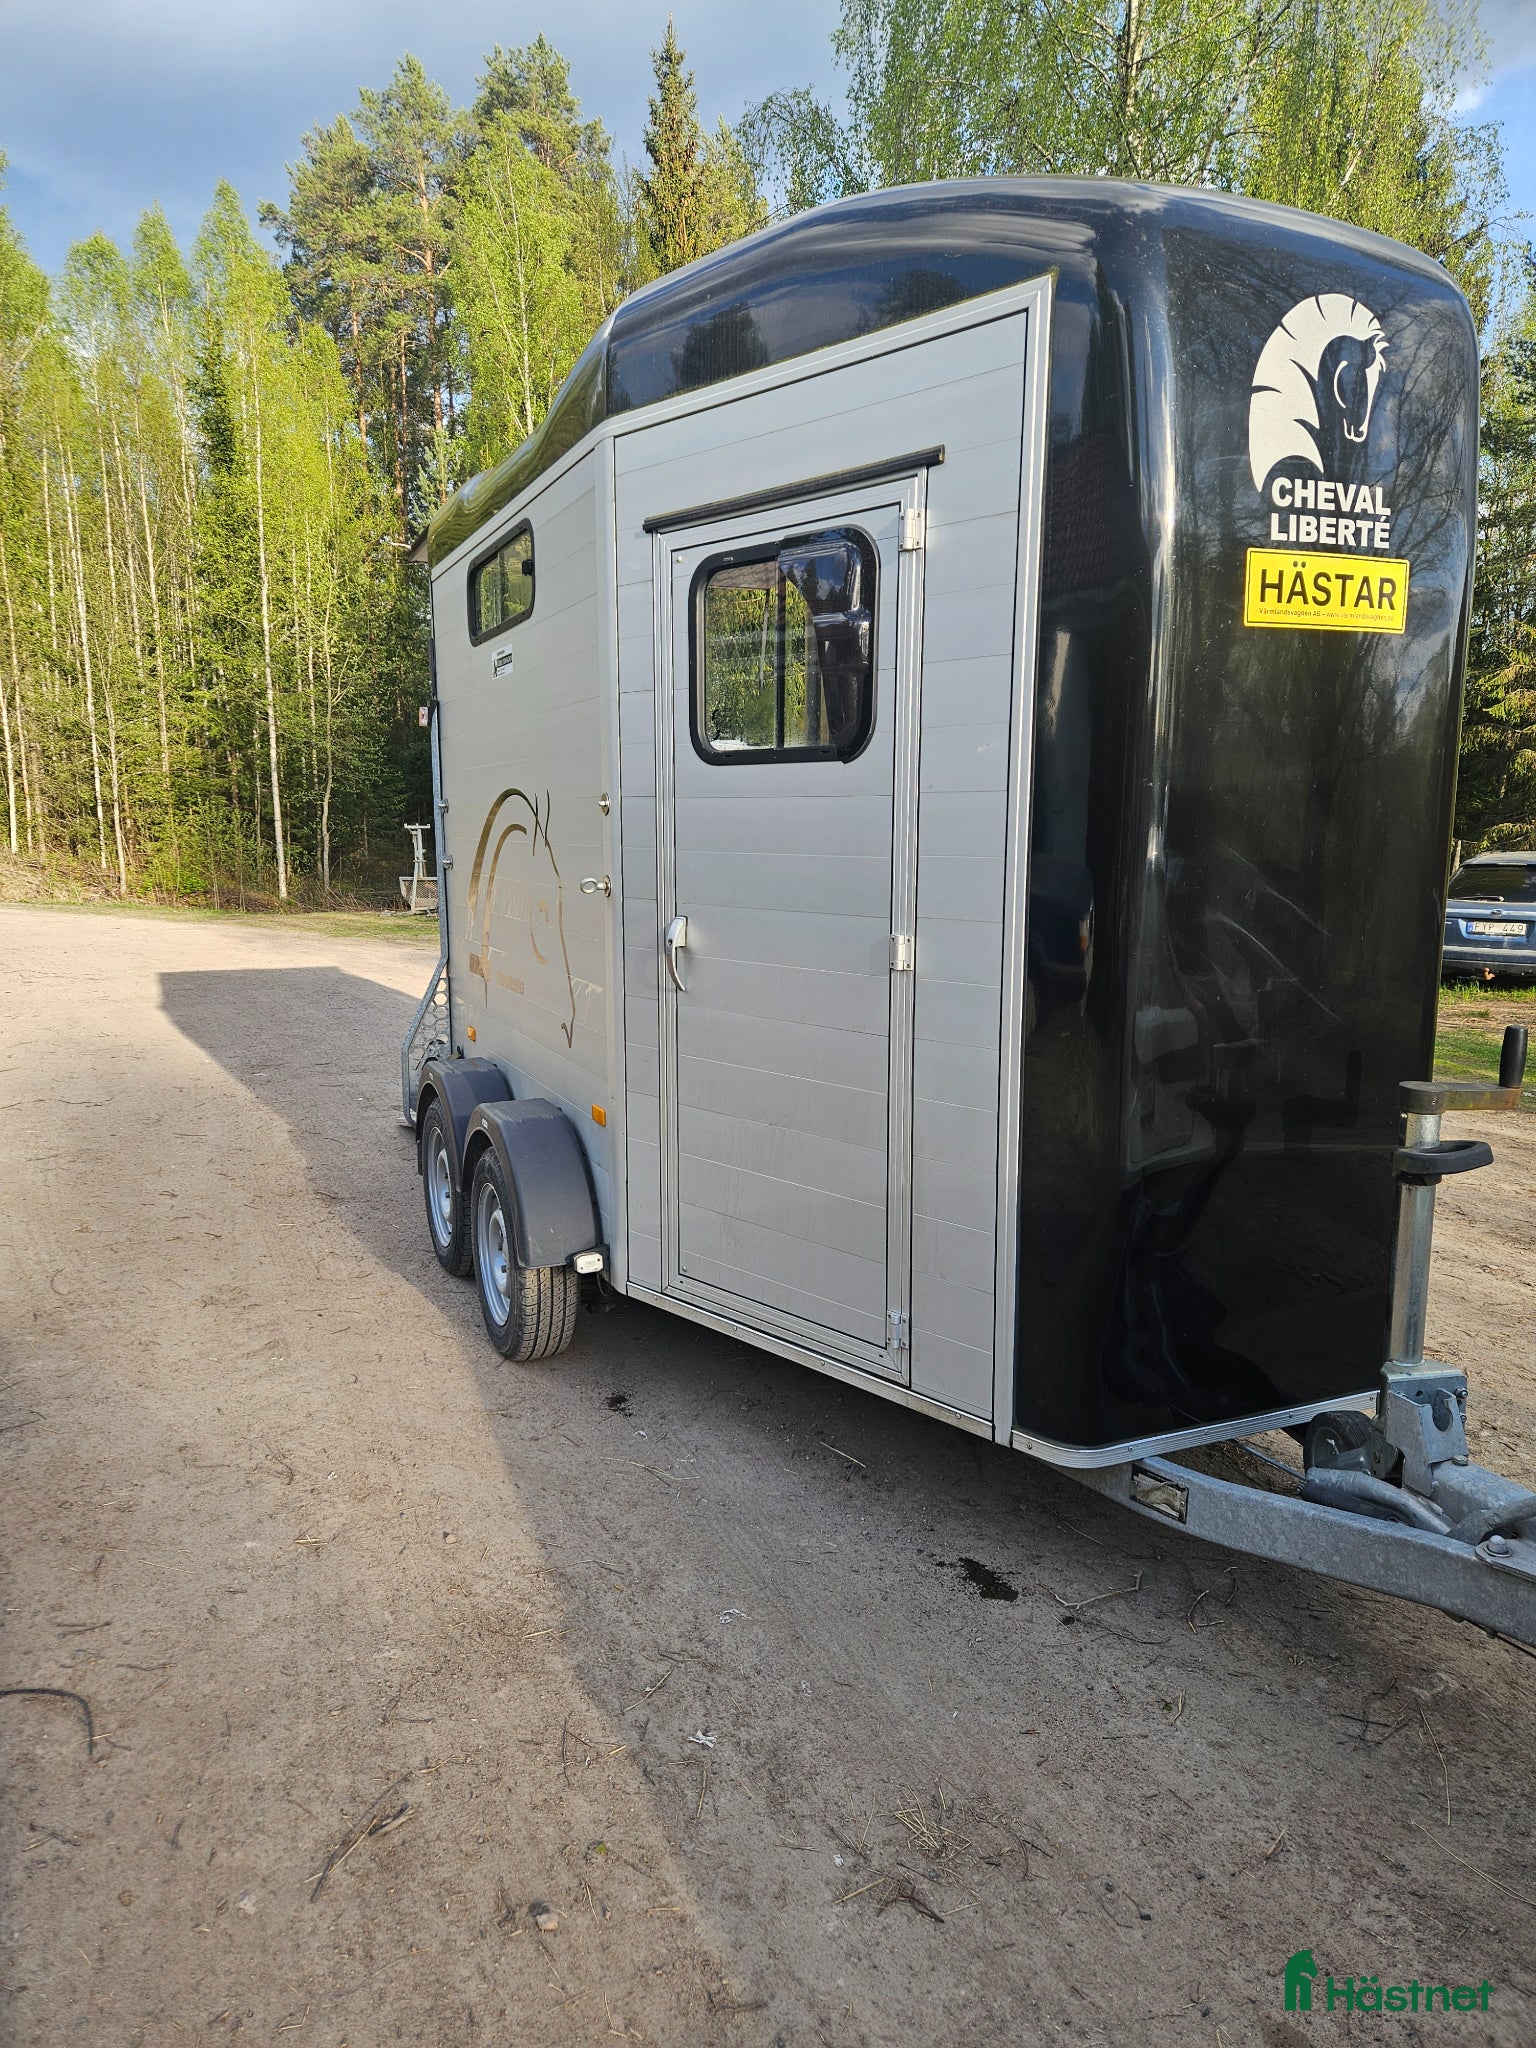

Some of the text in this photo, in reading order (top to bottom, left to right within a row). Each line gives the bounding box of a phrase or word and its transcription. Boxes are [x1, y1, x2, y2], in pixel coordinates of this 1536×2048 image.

[1271, 476, 1391, 516] CHEVAL
[1270, 512, 1391, 549] LIBERTÉ
[1259, 560, 1397, 610] HÄSTAR
[1502, 924, 1524, 933] 449
